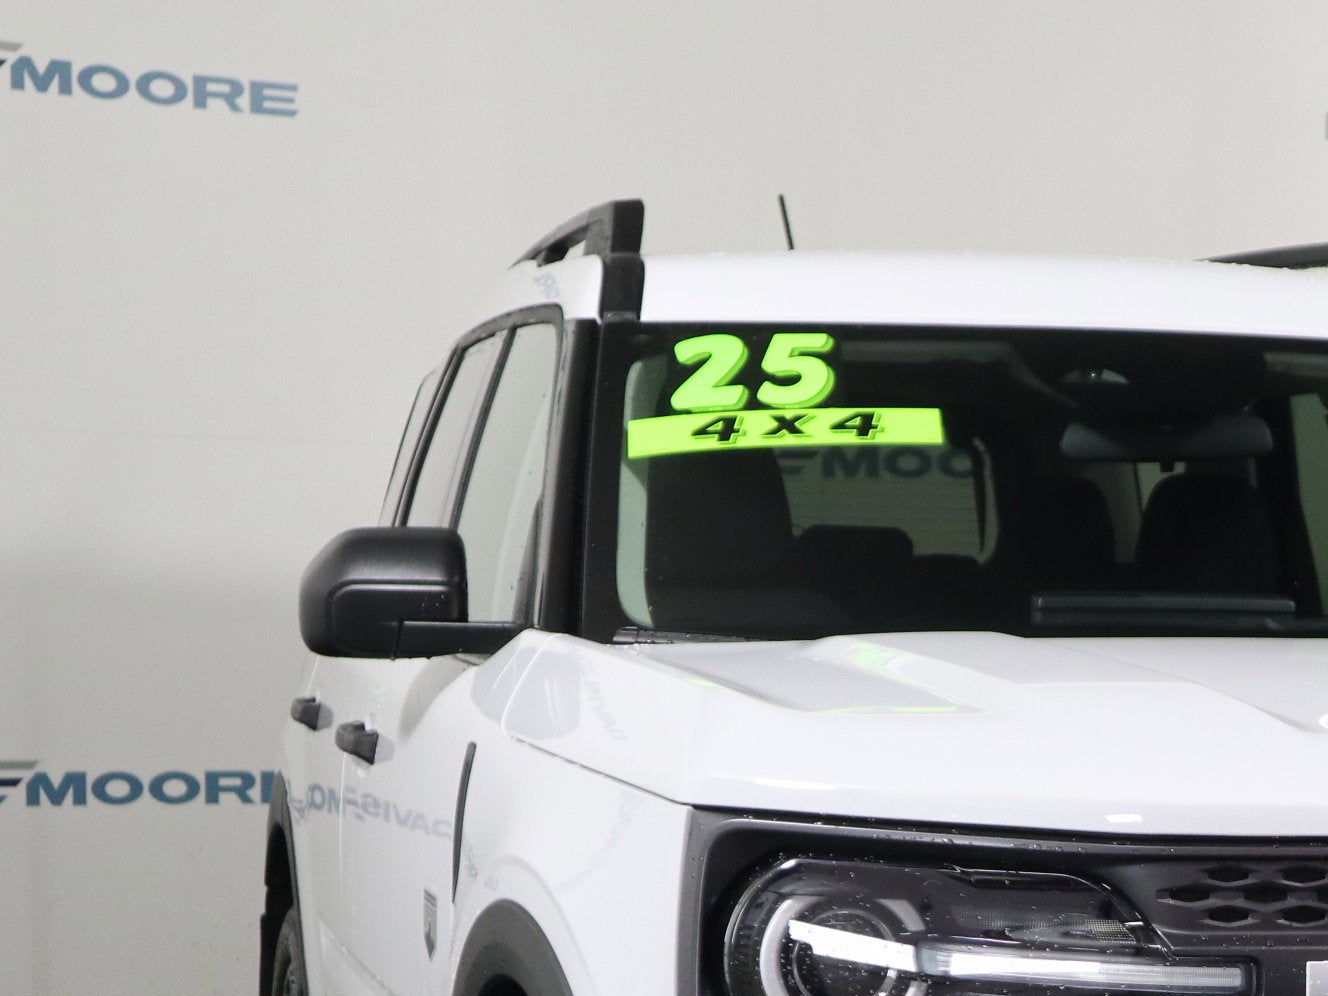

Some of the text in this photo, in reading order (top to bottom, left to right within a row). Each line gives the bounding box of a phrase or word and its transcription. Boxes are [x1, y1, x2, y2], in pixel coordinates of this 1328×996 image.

[10, 55, 299, 117] MOORE
[670, 333, 835, 411] 25
[821, 445, 973, 478] MOO
